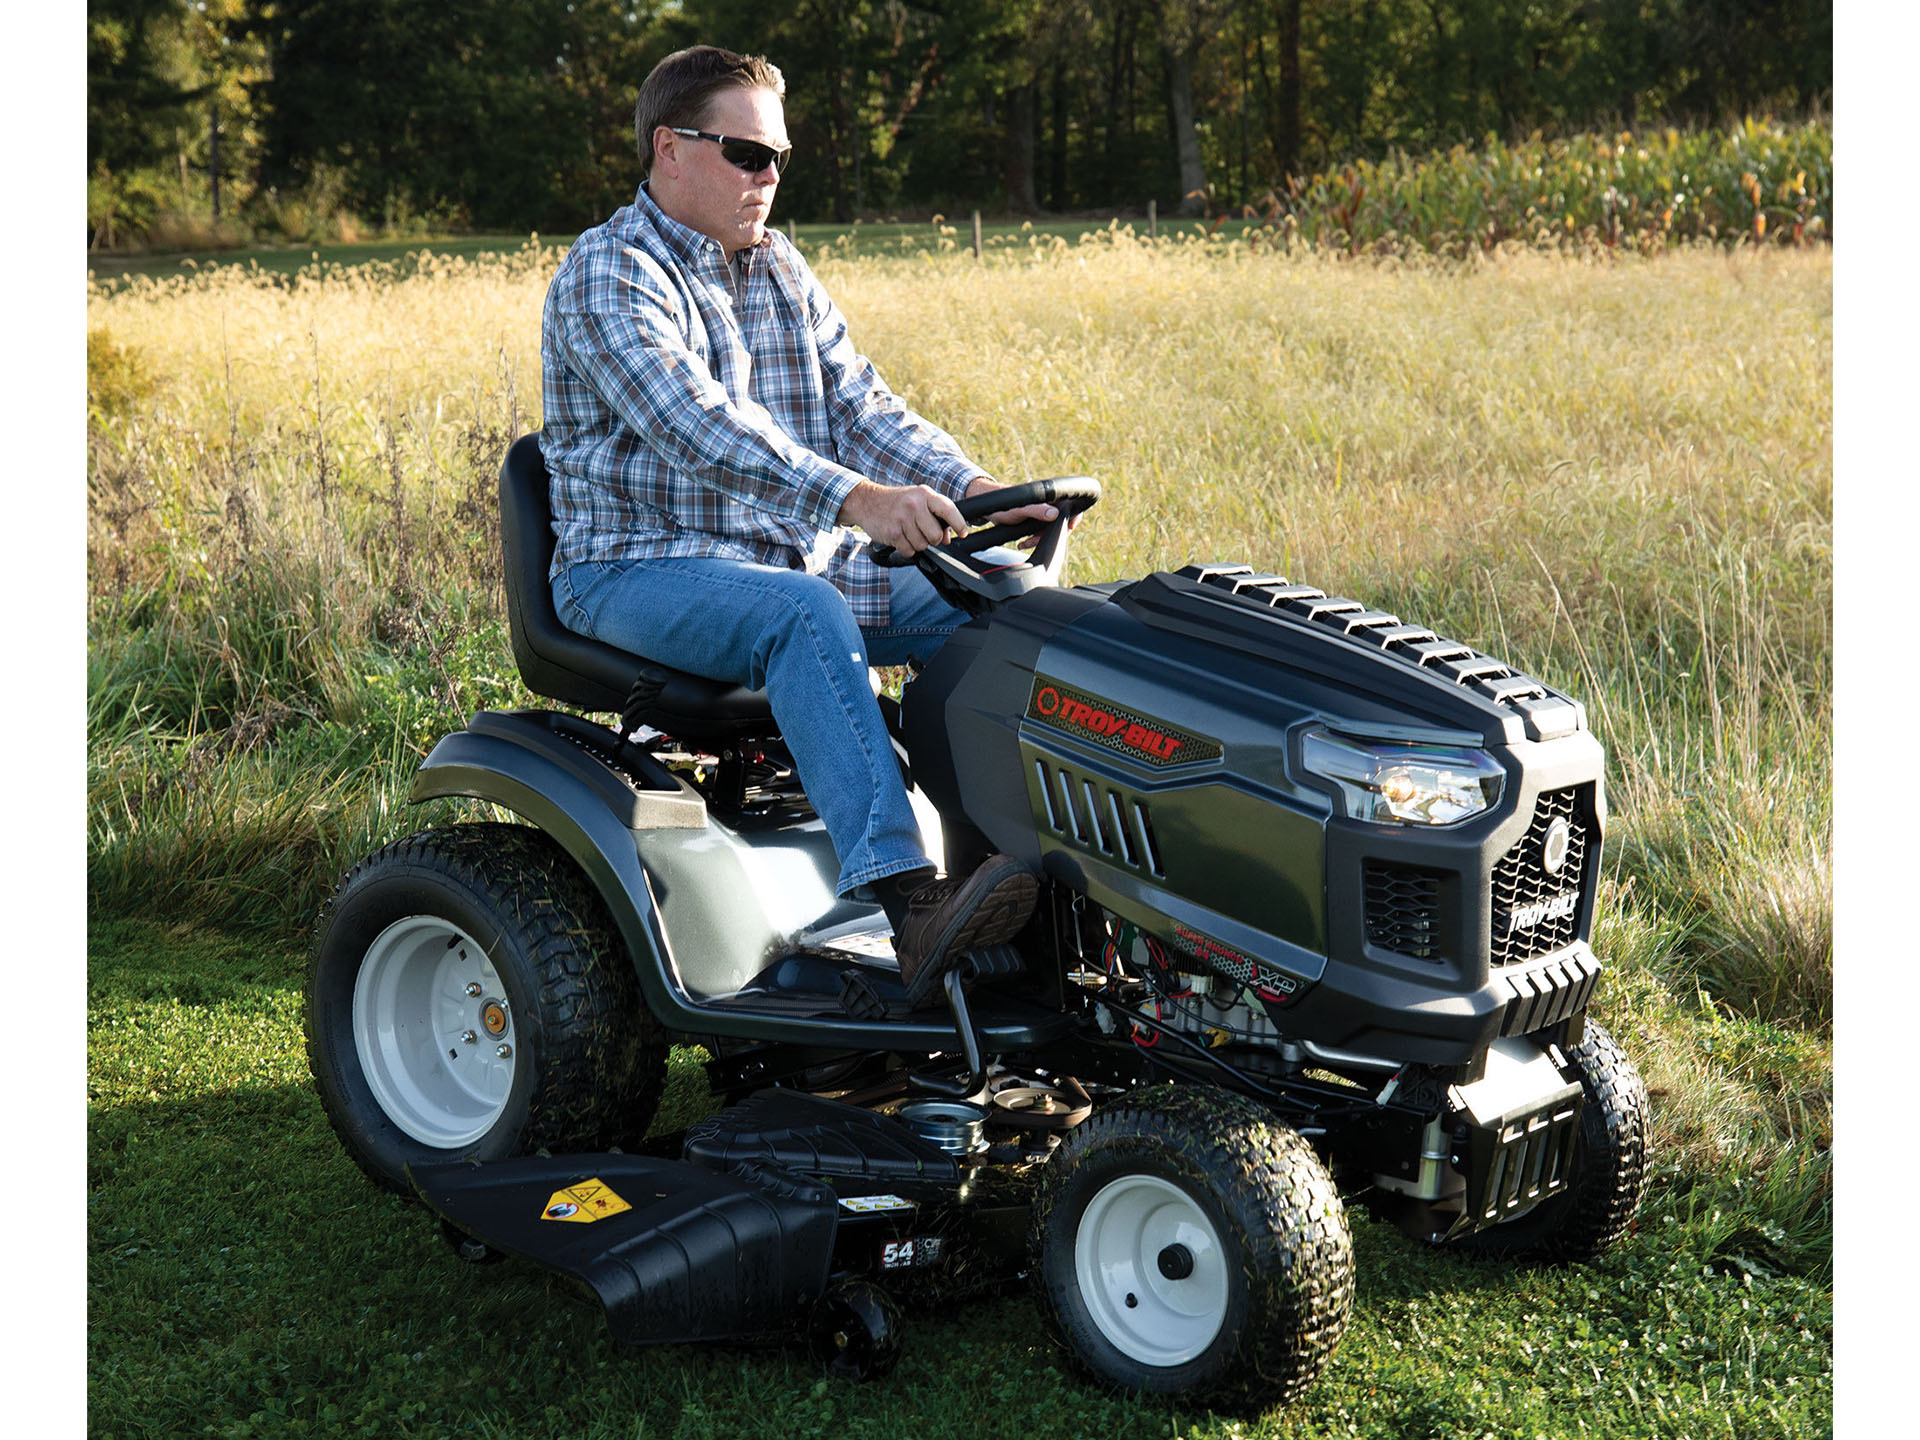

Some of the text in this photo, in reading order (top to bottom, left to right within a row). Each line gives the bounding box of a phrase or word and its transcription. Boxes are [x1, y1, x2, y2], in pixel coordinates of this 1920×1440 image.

[1058, 697, 1181, 760] TROY-BILT
[1510, 892, 1580, 932] TROY-BILT
[1176, 927, 1244, 964] SUPER BRONCO
[1250, 964, 1297, 996] XP
[883, 1241, 914, 1263] 54
